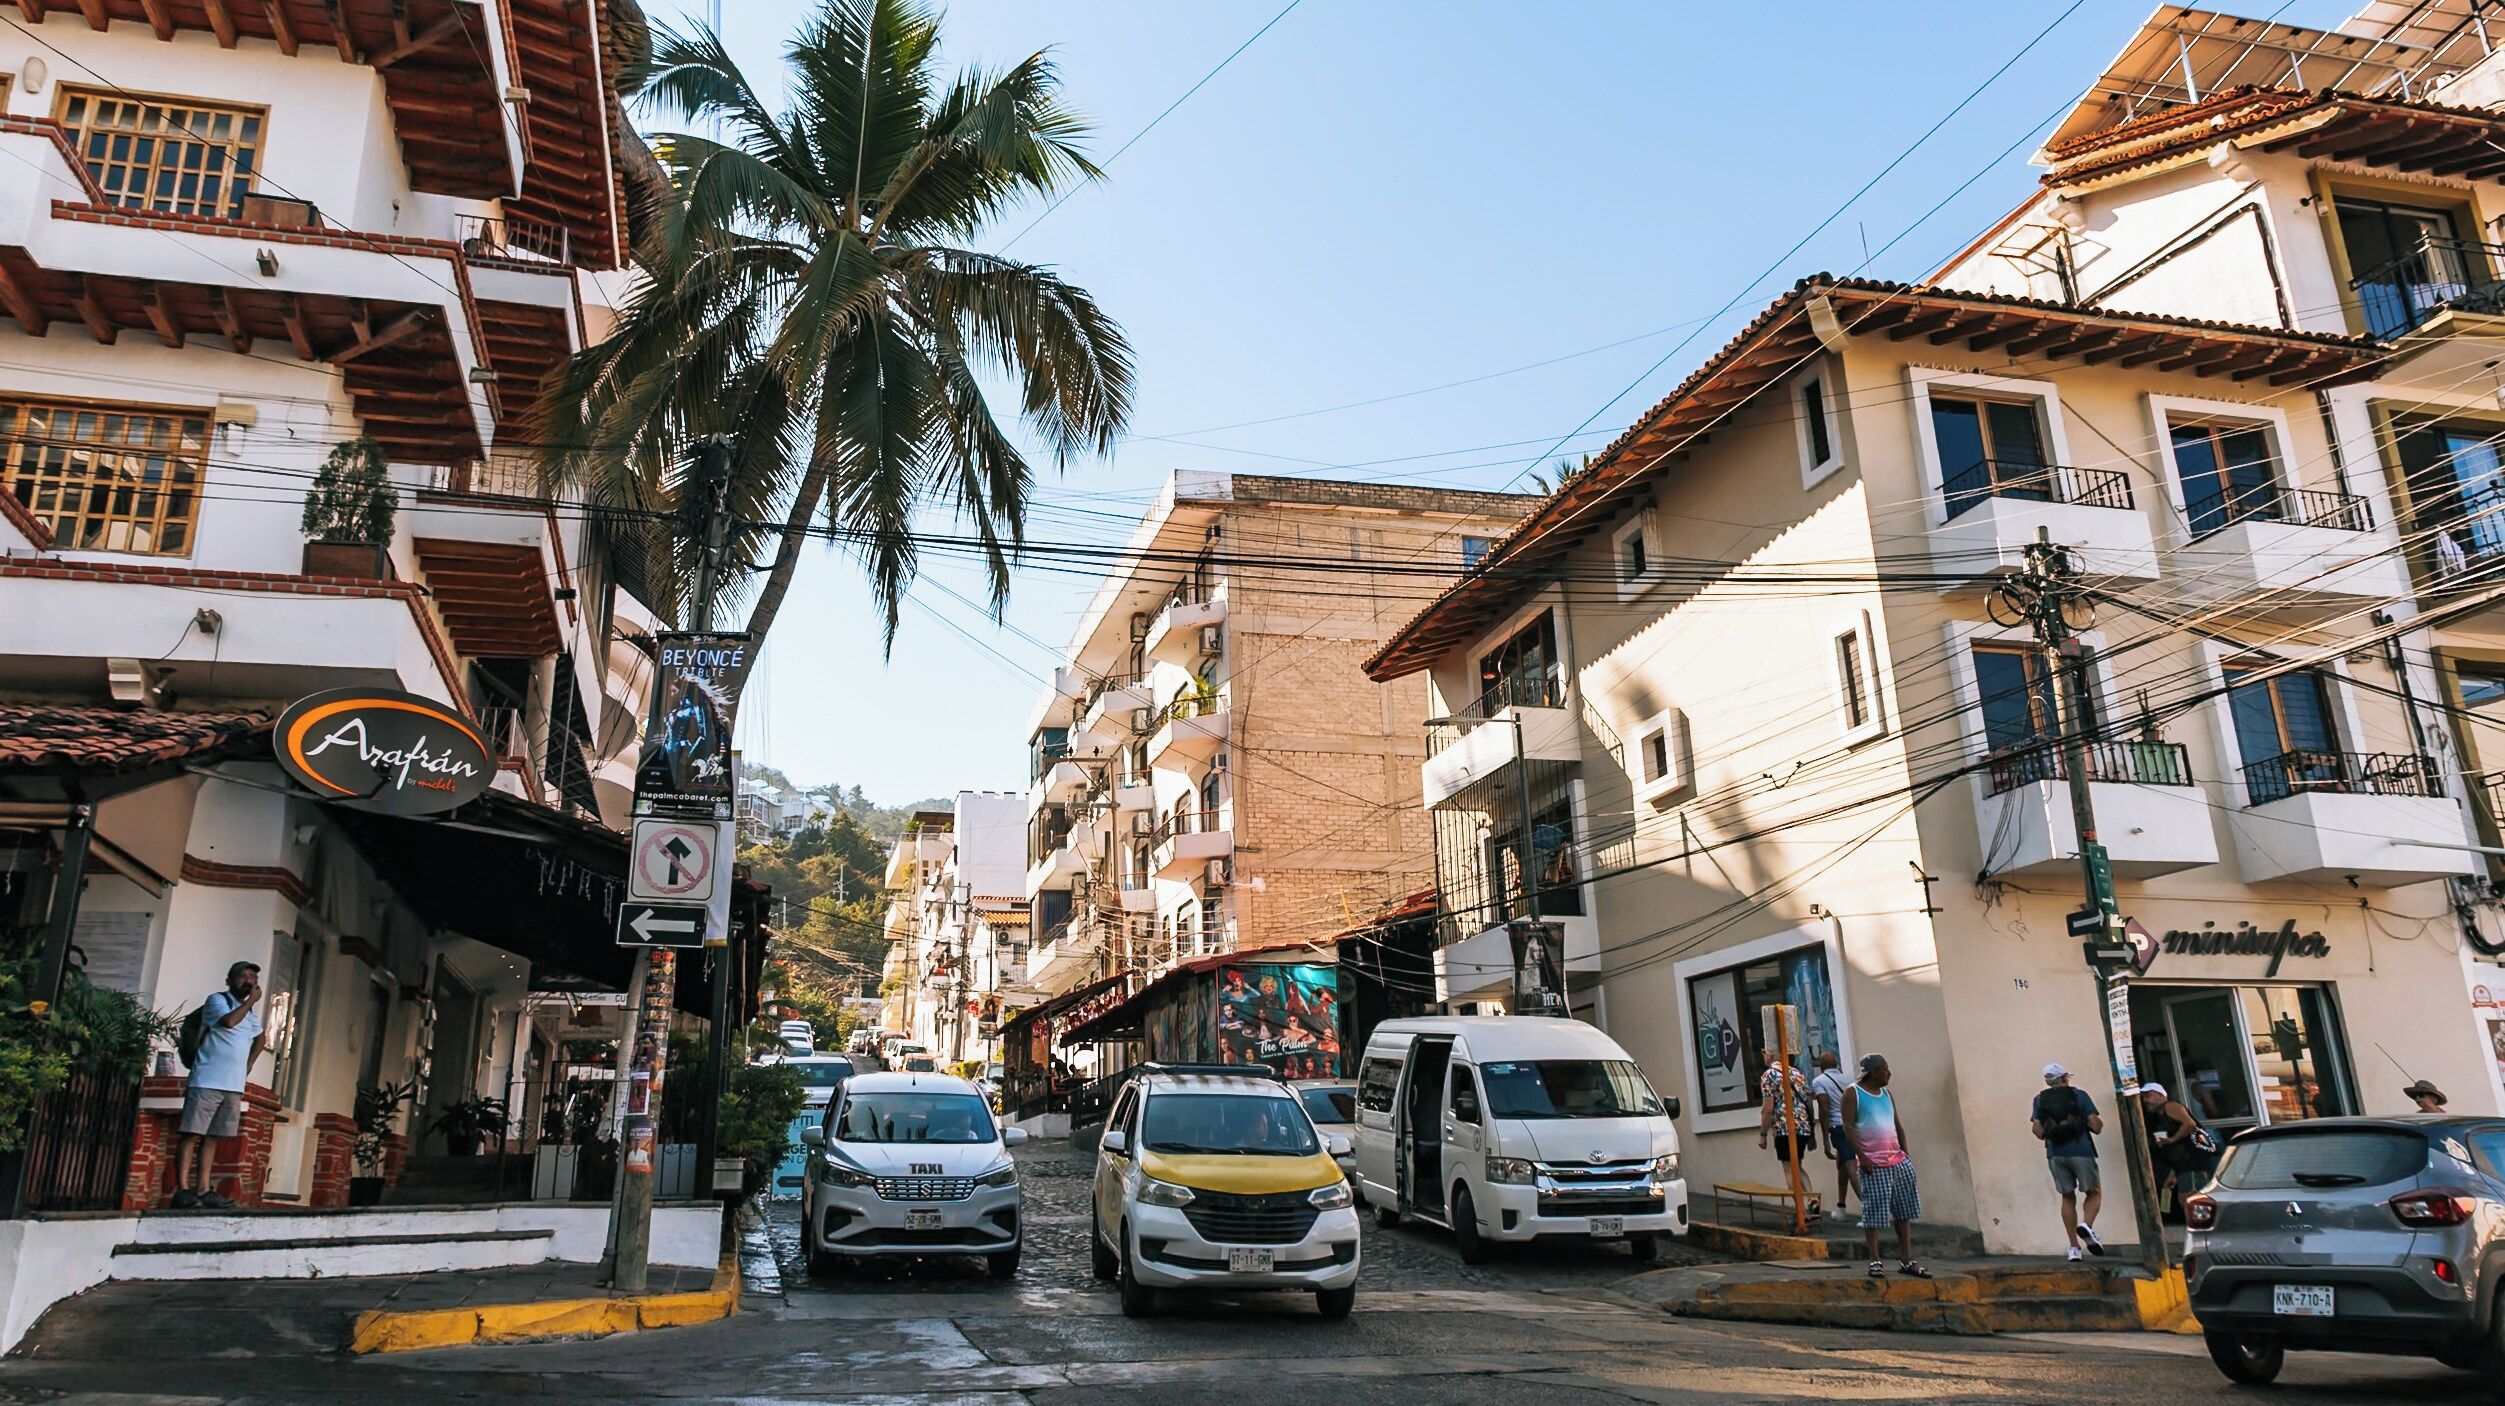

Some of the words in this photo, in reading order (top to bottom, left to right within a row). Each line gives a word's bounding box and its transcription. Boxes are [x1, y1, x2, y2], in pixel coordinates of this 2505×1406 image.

[662, 645, 744, 667] BEYONCÉ
[675, 667, 725, 677] TRIBUTE
[639, 791, 729, 802] thepalmcabaret.com
[1255, 1039, 1277, 1054] The
[1279, 1037, 1308, 1052] Palm
[909, 1163, 943, 1175] TAXI
[2275, 1292, 2332, 1308] KNK-710-A
